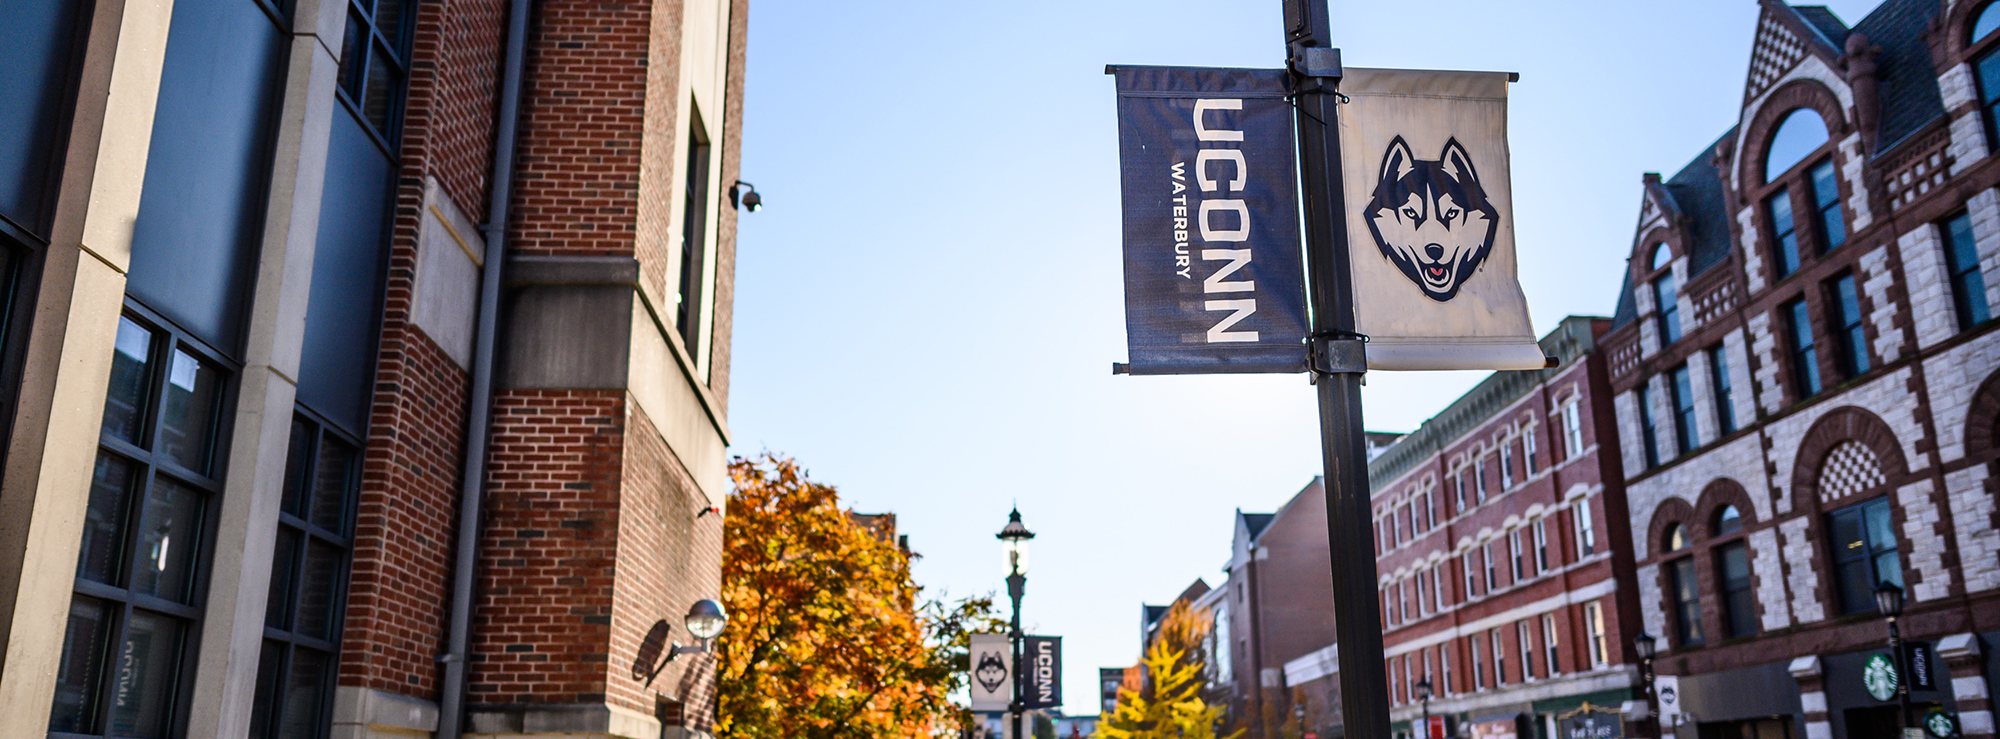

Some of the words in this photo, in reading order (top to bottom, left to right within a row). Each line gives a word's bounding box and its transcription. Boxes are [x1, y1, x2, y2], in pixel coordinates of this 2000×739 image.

[1171, 162, 1191, 279] WATERBURY
[1193, 99, 1259, 343] UCONN
[1038, 641, 1053, 703] UCONN
